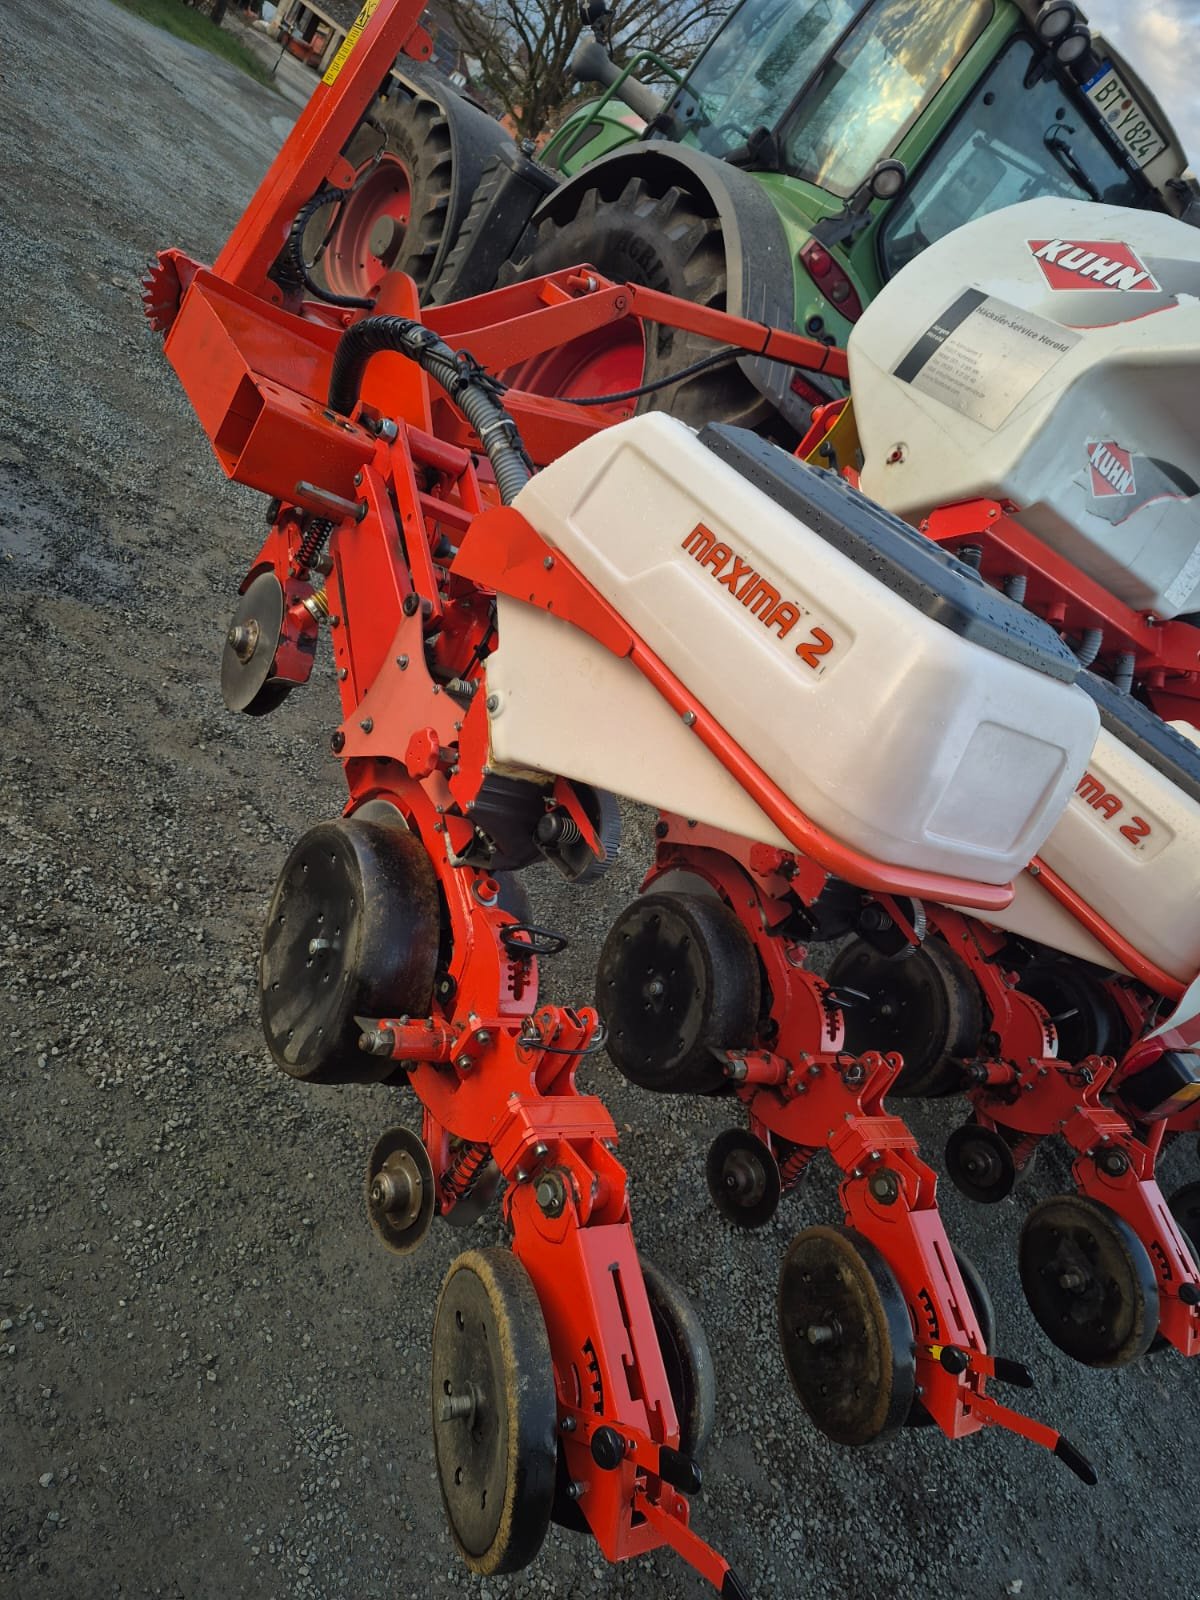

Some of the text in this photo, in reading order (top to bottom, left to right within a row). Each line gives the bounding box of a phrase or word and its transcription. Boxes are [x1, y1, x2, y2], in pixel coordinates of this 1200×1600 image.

[1094, 78, 1127, 111] BT
[1116, 107, 1139, 130] Y
[1123, 121, 1158, 158] 824
[1032, 238, 1151, 292] KUHN
[1038, 334, 1071, 354] Herold
[1089, 441, 1134, 495] KUHN
[681, 521, 834, 669] MAXIMA 2
[1074, 770, 1151, 845] MA 2
